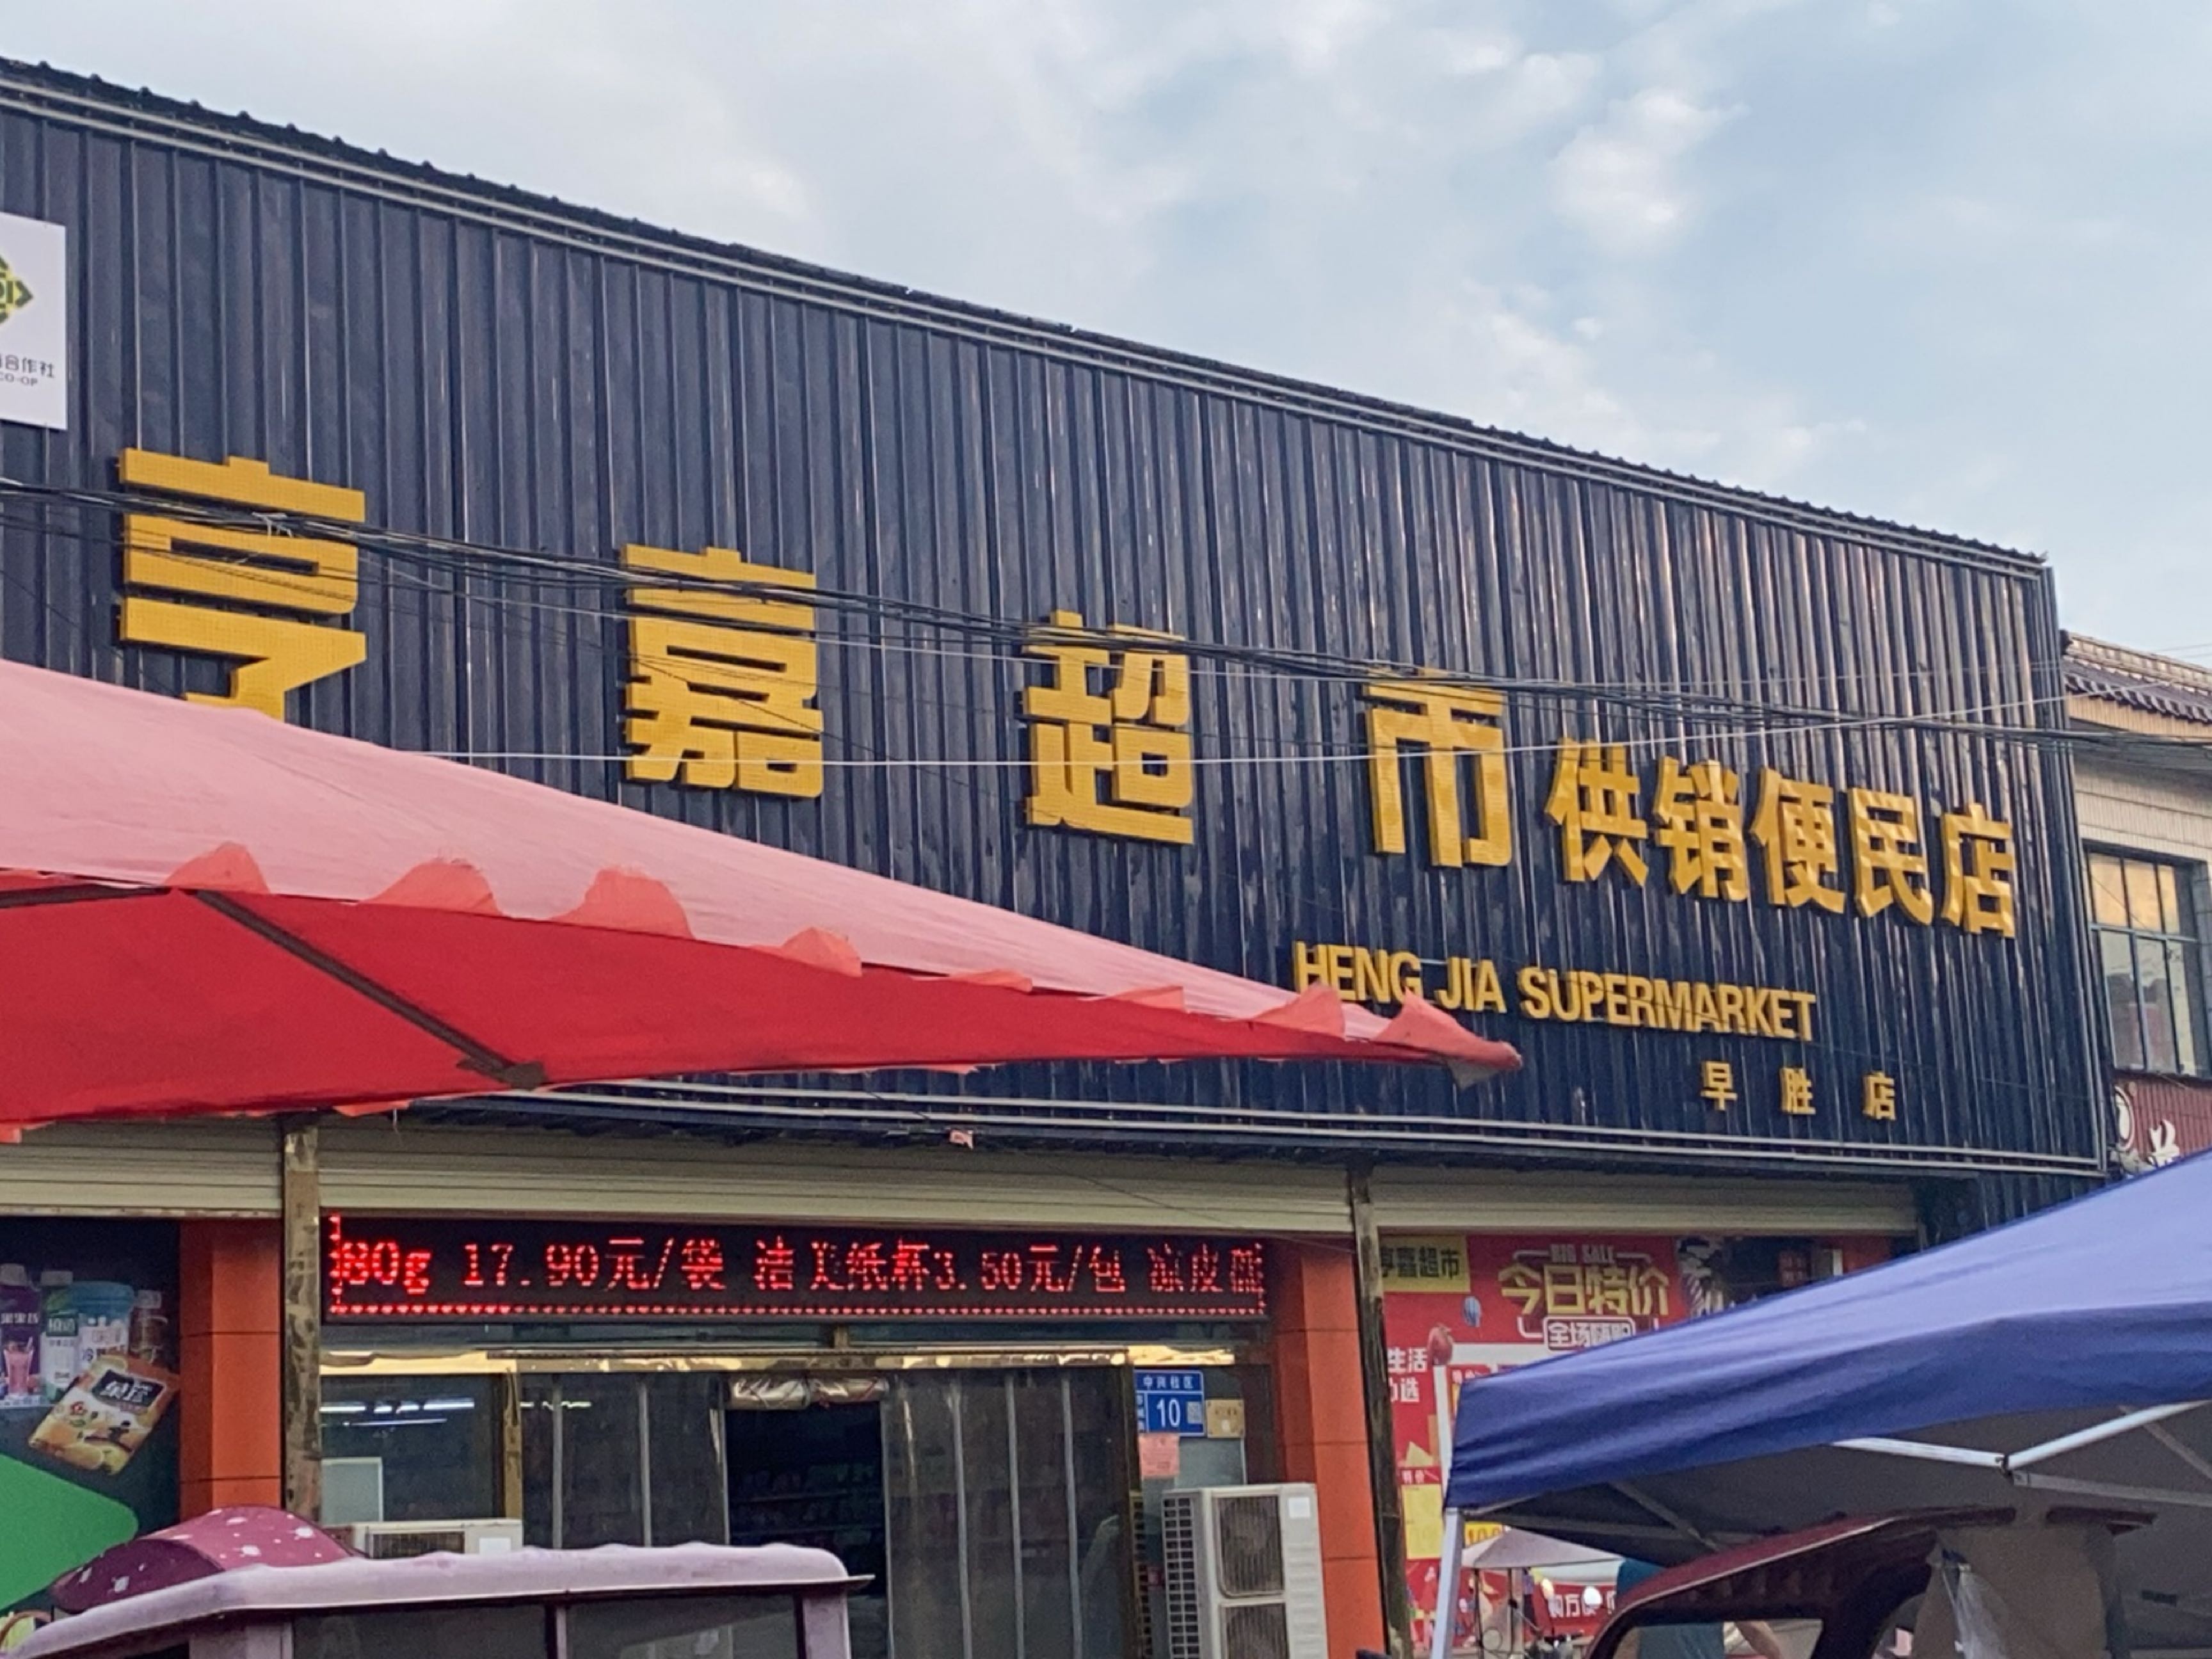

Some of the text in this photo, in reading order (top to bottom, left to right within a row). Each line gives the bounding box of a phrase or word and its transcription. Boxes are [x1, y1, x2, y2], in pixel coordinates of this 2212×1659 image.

[1544, 737, 2016, 940] 供销便民店
[1293, 940, 1816, 1041] HENG JIA SUPERMARKET
[1700, 1060, 1896, 1121] 早胜店
[1498, 1263, 1669, 1316] 今日特价
[1156, 1398, 1181, 1428] 10
